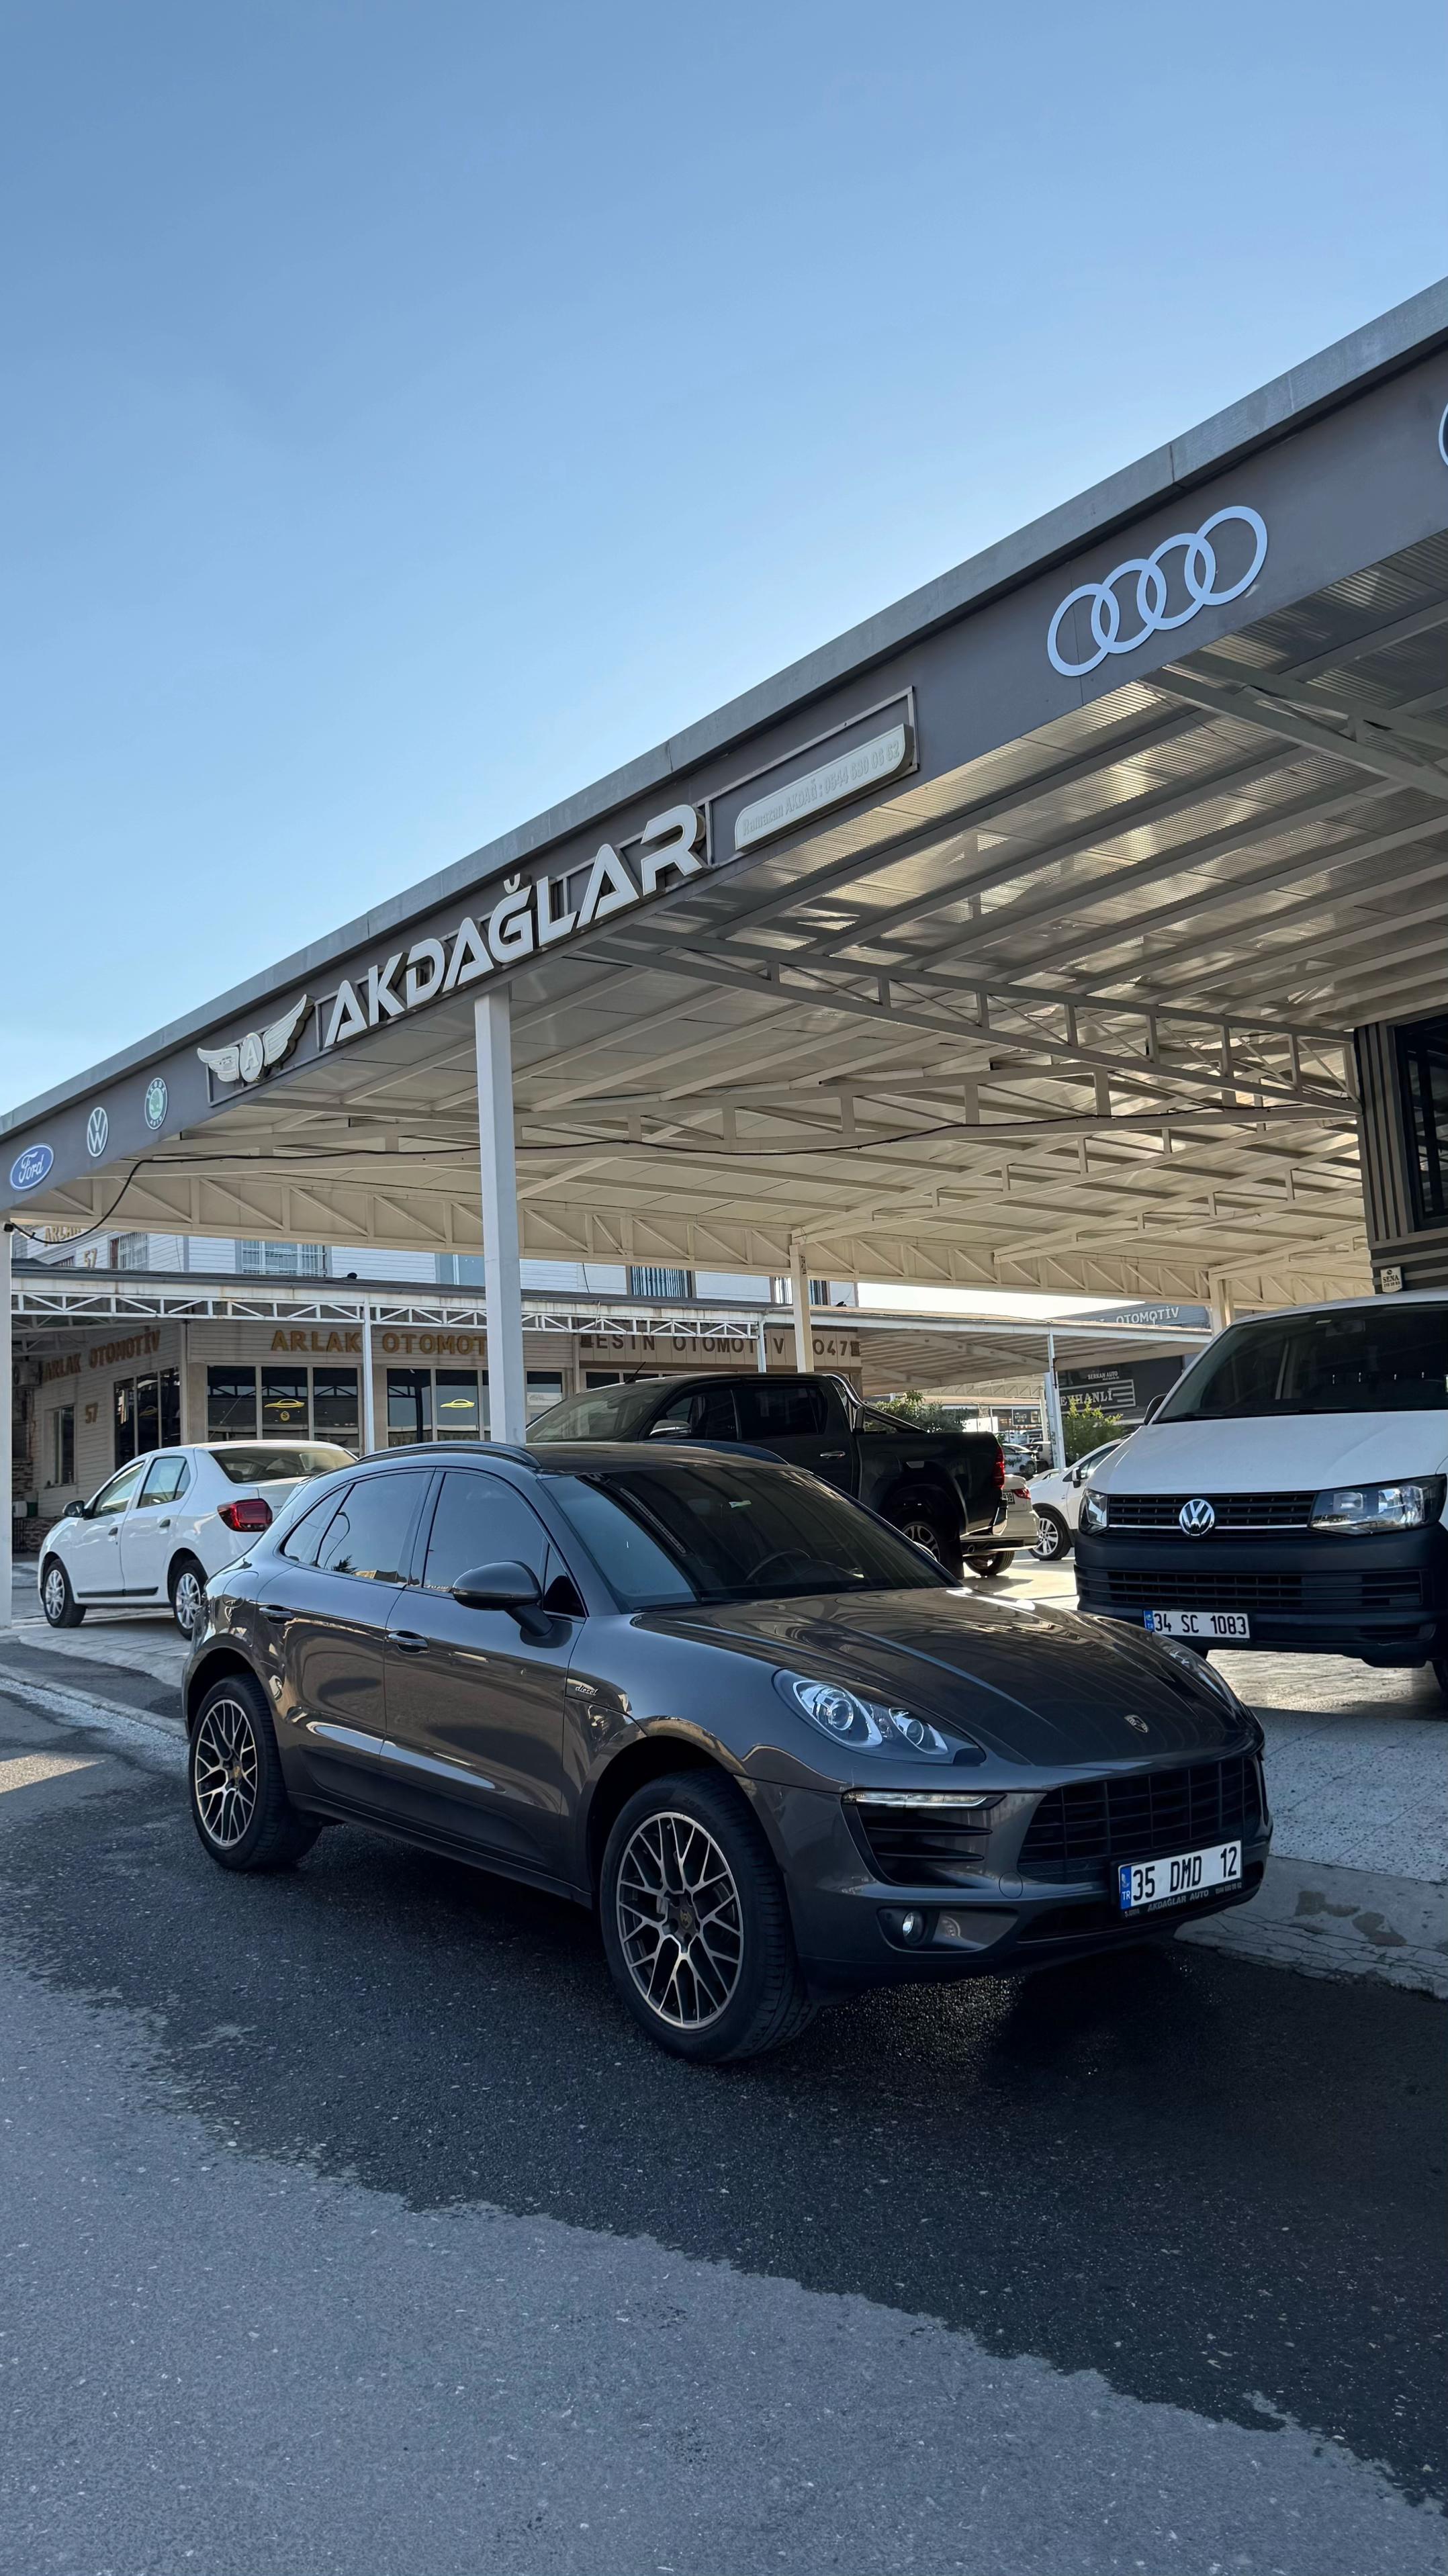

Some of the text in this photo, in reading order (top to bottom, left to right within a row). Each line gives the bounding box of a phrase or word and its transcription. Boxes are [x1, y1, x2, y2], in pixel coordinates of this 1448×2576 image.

[324, 804, 703, 1048] AKDAĞLAR
[18, 1151, 44, 1183] Ford
[271, 1330, 489, 1356] ARLAK OTOMOT
[85, 1402, 99, 1424] 57
[1154, 1613, 1172, 1632] 34
[1181, 1614, 1200, 1633] SC
[1210, 1615, 1247, 1635] 1083
[1122, 1846, 1237, 1901] TR 35 DMD 12
[1147, 1889, 1210, 1913] AKDAĞLAR AUTO
